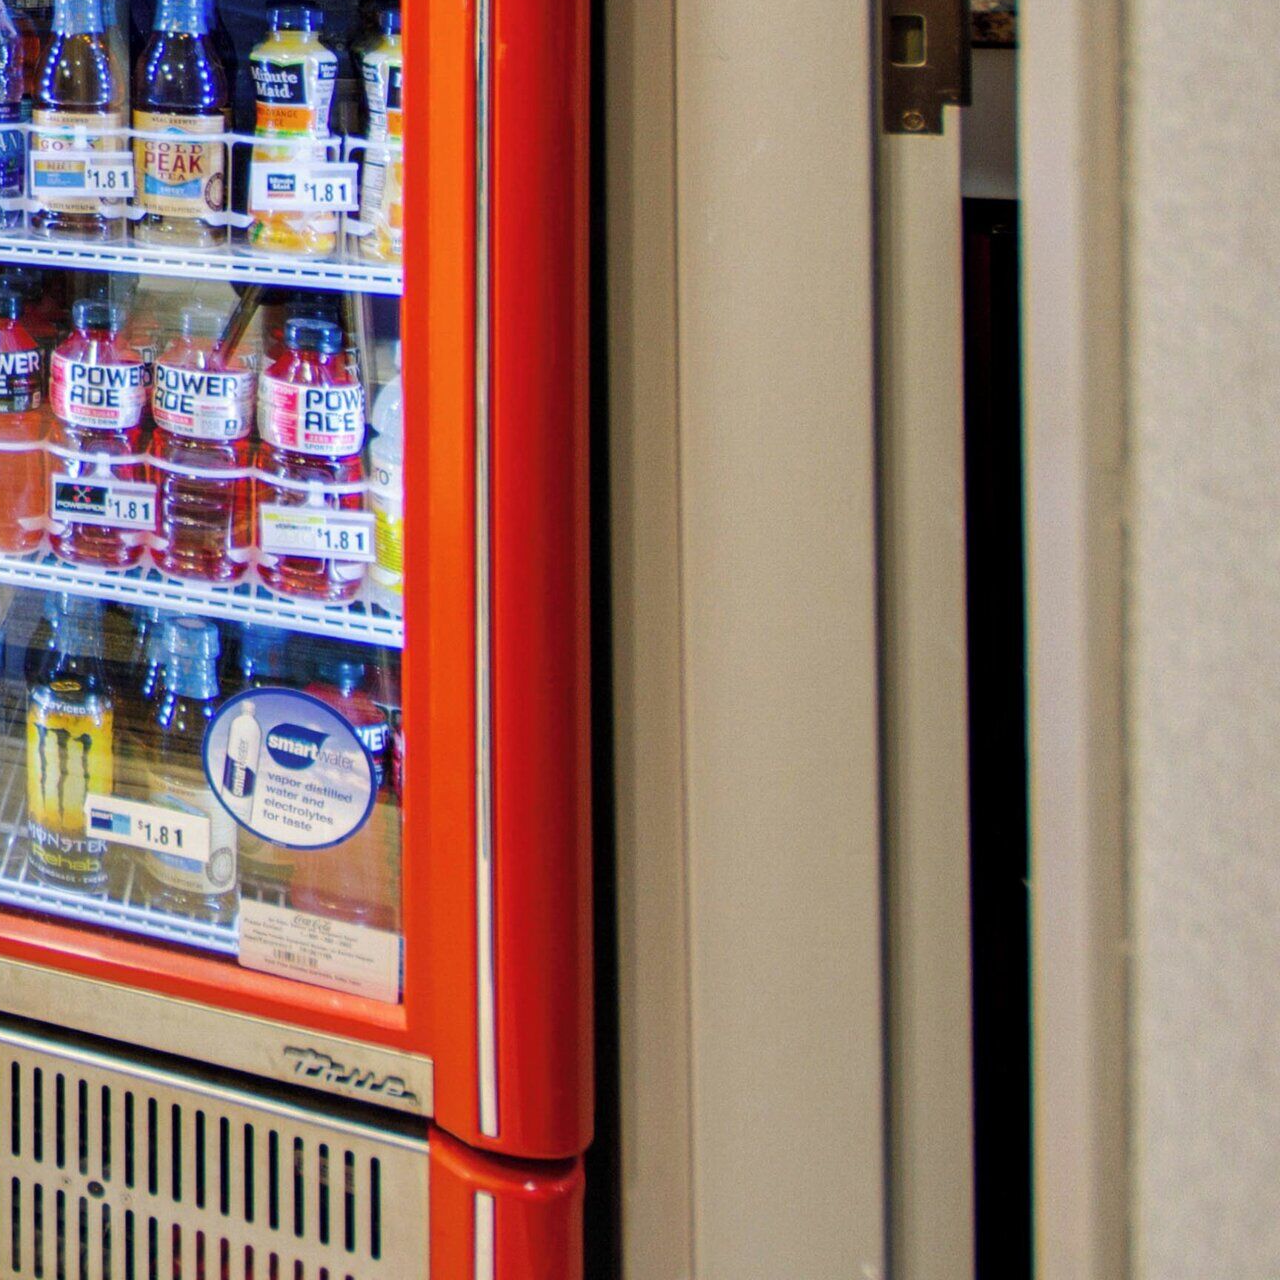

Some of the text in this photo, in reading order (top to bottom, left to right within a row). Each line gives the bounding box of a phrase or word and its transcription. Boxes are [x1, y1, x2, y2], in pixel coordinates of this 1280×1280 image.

[250, 66, 298, 83] Minute
[256, 81, 291, 98] Maid
[145, 141, 203, 154] GOLD
[144, 151, 203, 173] PEAK
[87, 169, 130, 189] $1.81
[160, 173, 186, 181] TEA
[304, 183, 347, 202] $1.81
[156, 365, 238, 397] POWER
[70, 384, 120, 407] ADE
[155, 386, 194, 414] ADE
[108, 498, 150, 520] $1.81
[317, 527, 364, 551] $1.81
[267, 732, 354, 771] smartwater
[266, 784, 324, 809] water and
[268, 771, 352, 804] vapor distilled
[263, 808, 312, 832] for taste
[264, 797, 334, 825] electrolytes
[138, 820, 183, 848] $1.81
[283, 1045, 418, 1102] true
